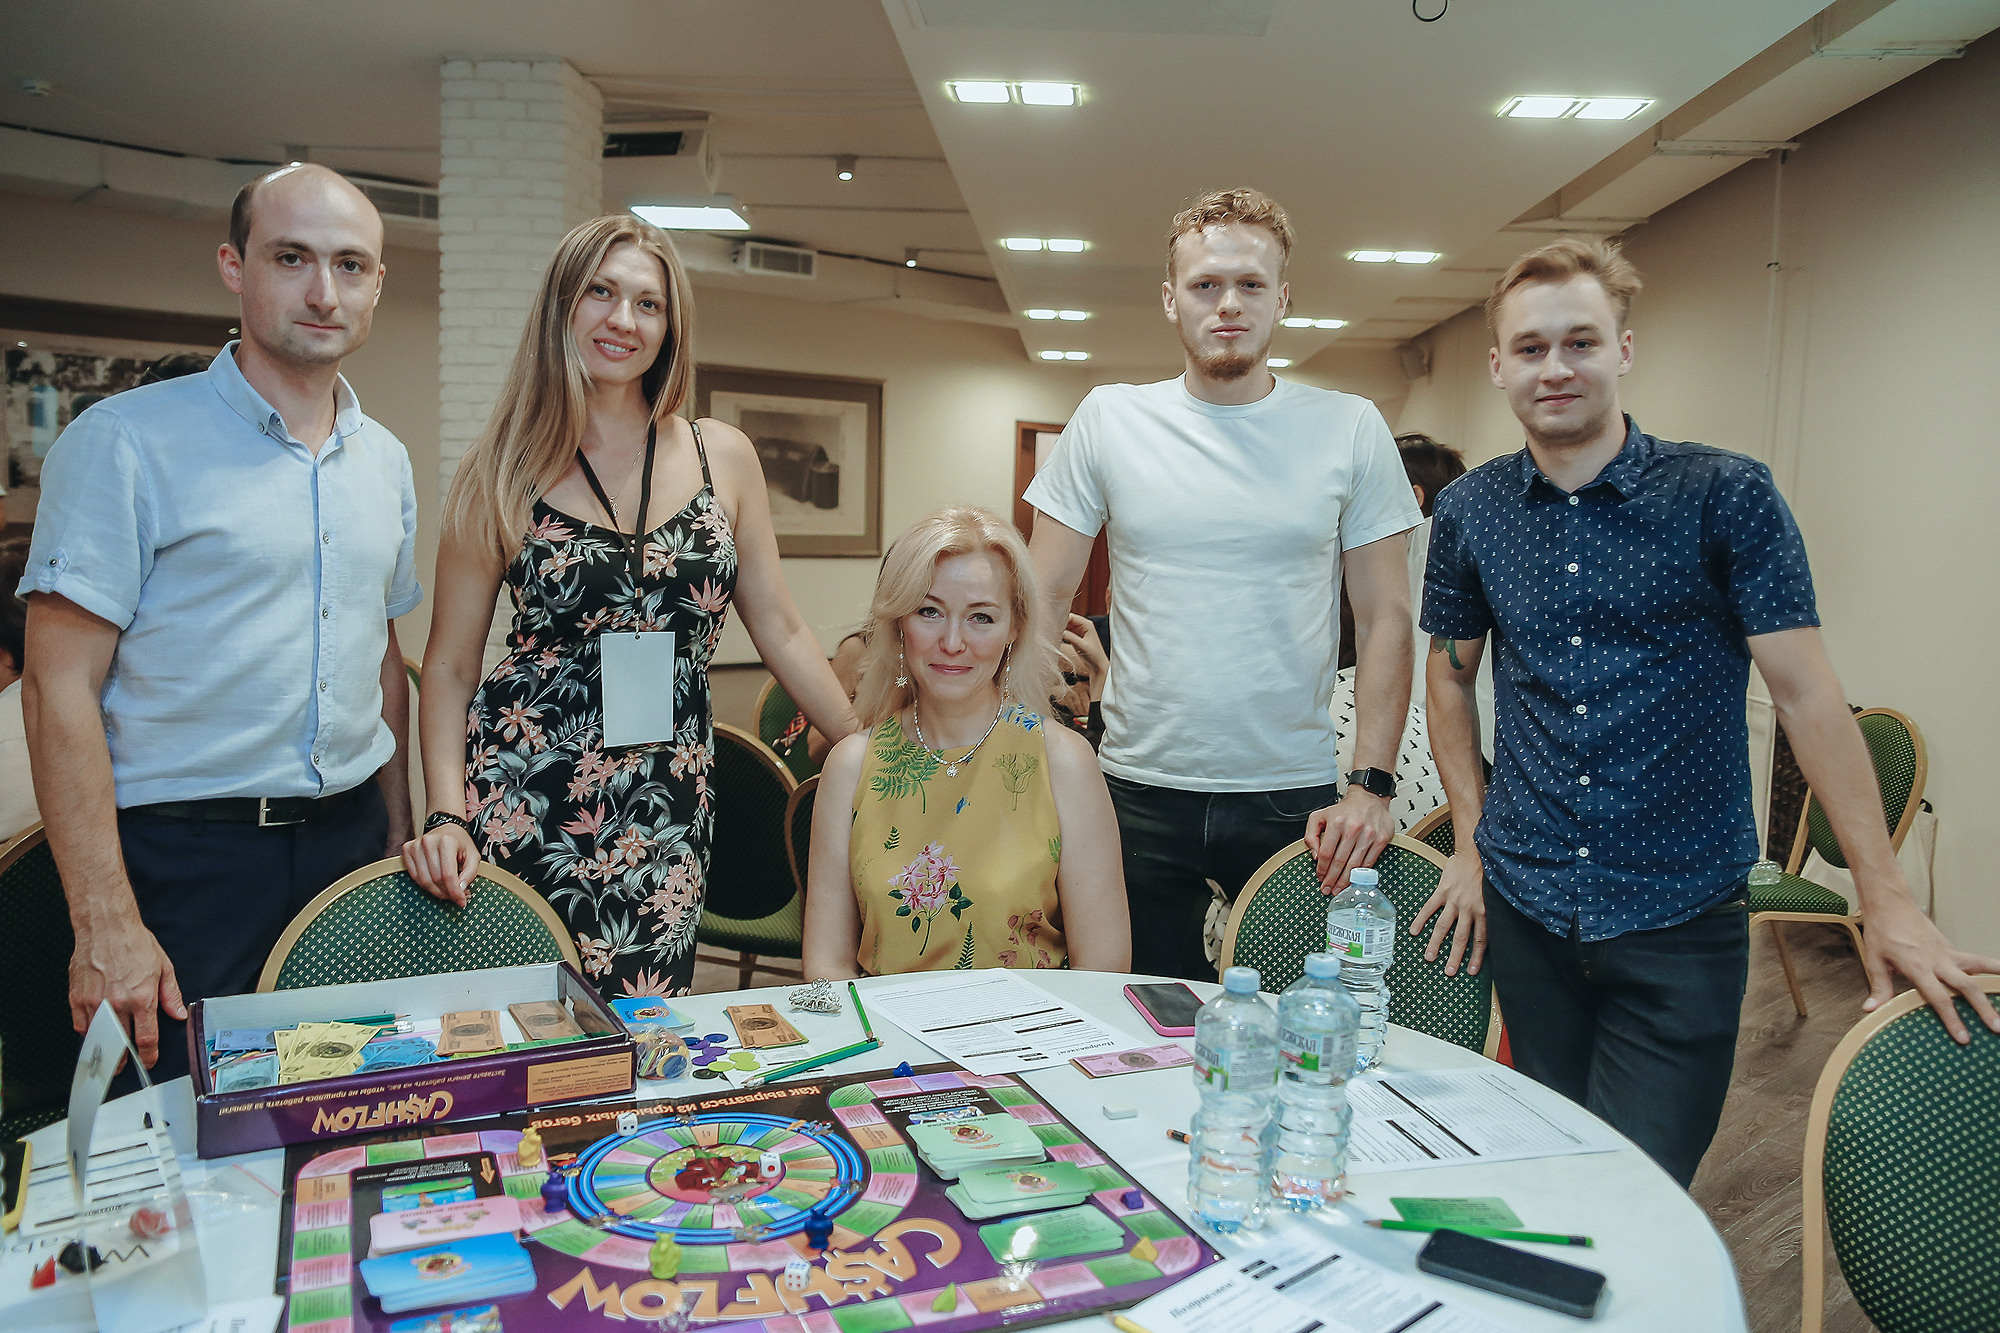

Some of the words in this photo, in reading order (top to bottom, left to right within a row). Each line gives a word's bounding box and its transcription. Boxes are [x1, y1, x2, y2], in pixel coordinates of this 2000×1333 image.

[414, 1077, 445, 1087] работать
[446, 1073, 472, 1082] деньги
[305, 1090, 346, 1102] пришлось
[360, 1086, 385, 1098] чтобы
[789, 1086, 820, 1098] Как
[266, 1096, 304, 1107] работать
[700, 1088, 786, 1110] вырваться
[218, 1102, 253, 1116] деньги!
[676, 1102, 696, 1114] из
[530, 1116, 582, 1130] бегов
